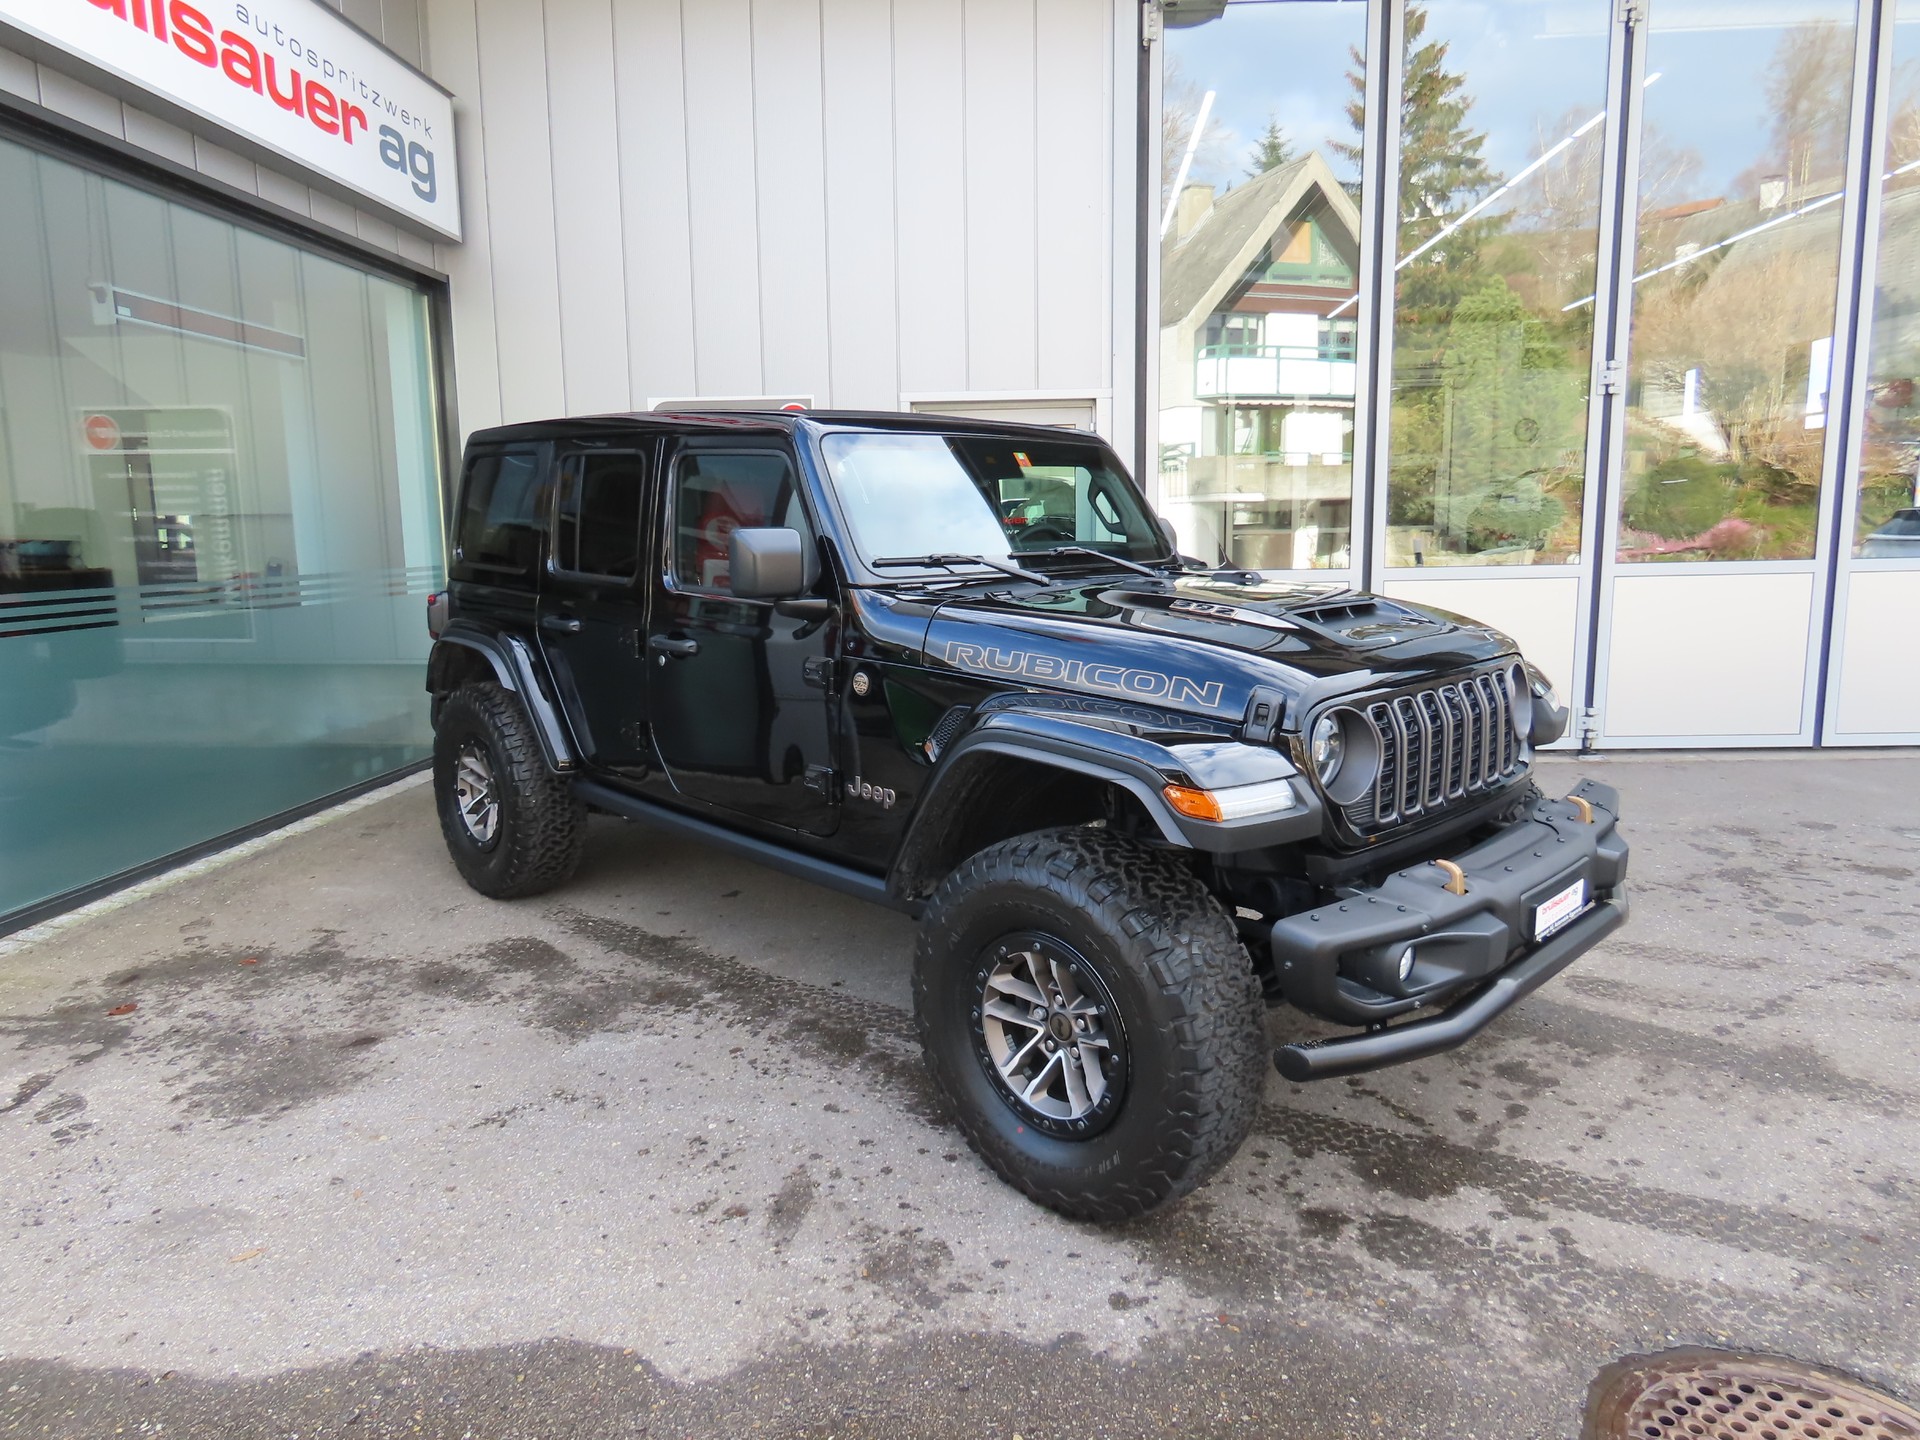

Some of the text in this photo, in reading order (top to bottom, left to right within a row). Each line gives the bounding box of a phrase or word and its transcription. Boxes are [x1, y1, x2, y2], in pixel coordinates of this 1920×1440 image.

[236, 3, 433, 140] autospritzwerk
[379, 124, 437, 204] ag
[946, 641, 1224, 707] RUBICON
[848, 775, 896, 809] Jeep
